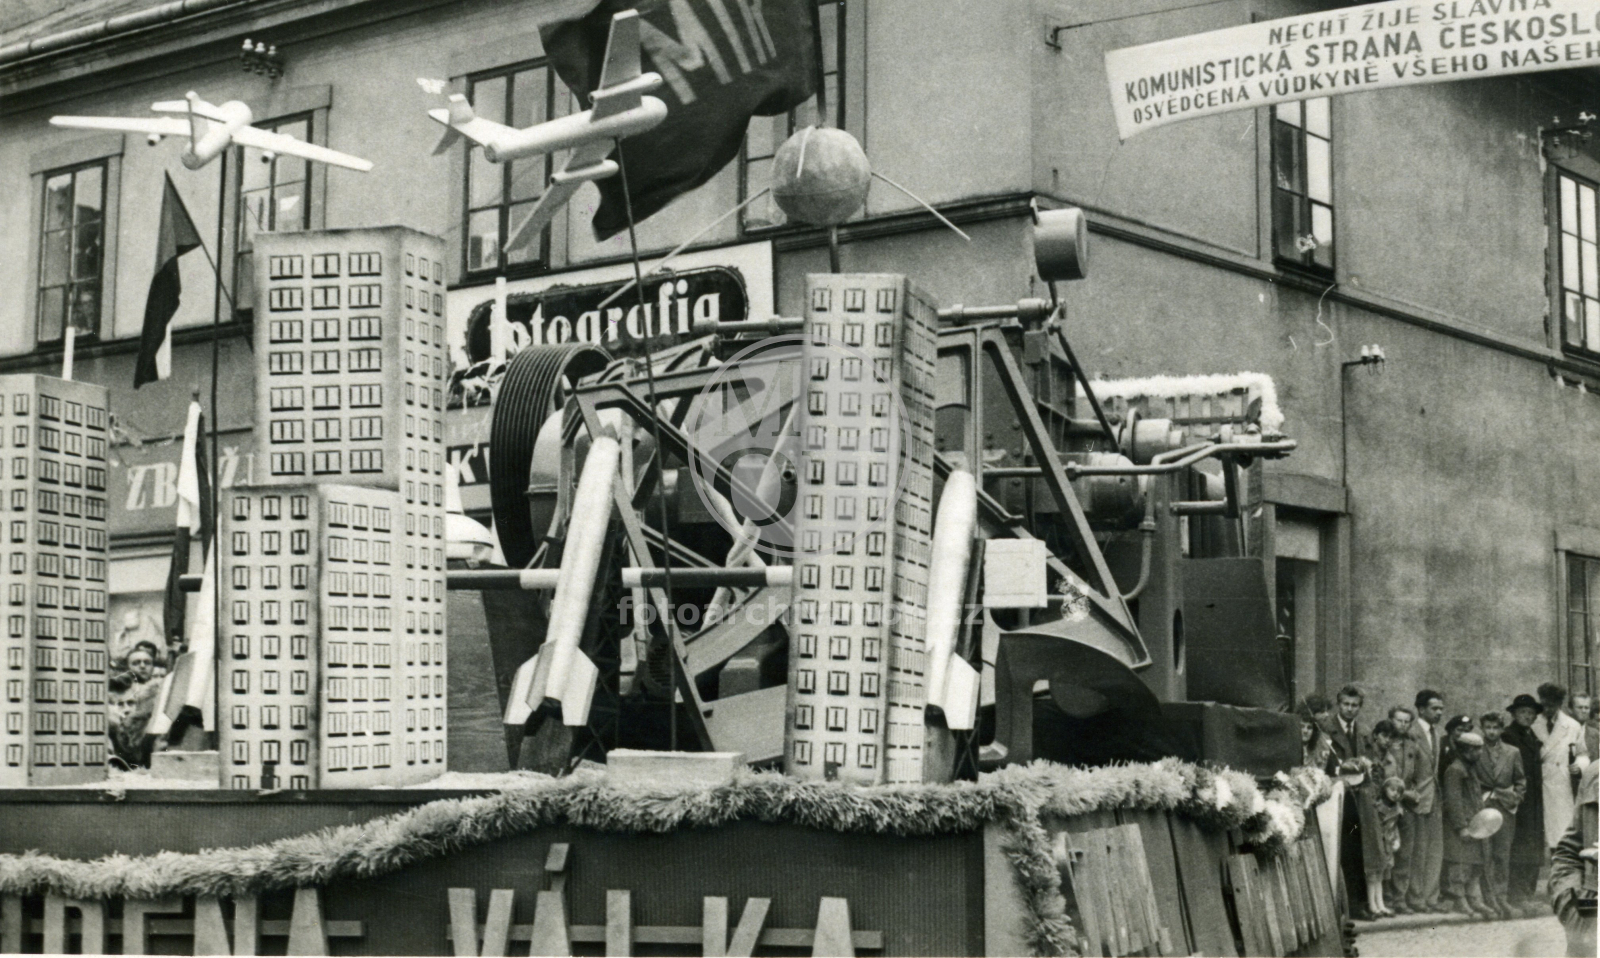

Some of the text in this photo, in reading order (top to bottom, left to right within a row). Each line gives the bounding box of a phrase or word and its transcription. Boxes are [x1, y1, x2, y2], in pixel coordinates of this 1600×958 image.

[1268, 13, 1349, 46] NECHŤ
[1361, 6, 1421, 32] ŽIJE
[1125, 43, 1293, 104] KOMUNISTICKÁ
[1304, 29, 1423, 68] STRANA
[1133, 79, 1251, 124] OSVĚDČENÁ
[1258, 60, 1380, 98] VŮDKYNĚ
[1392, 53, 1489, 79] VŠEHO
